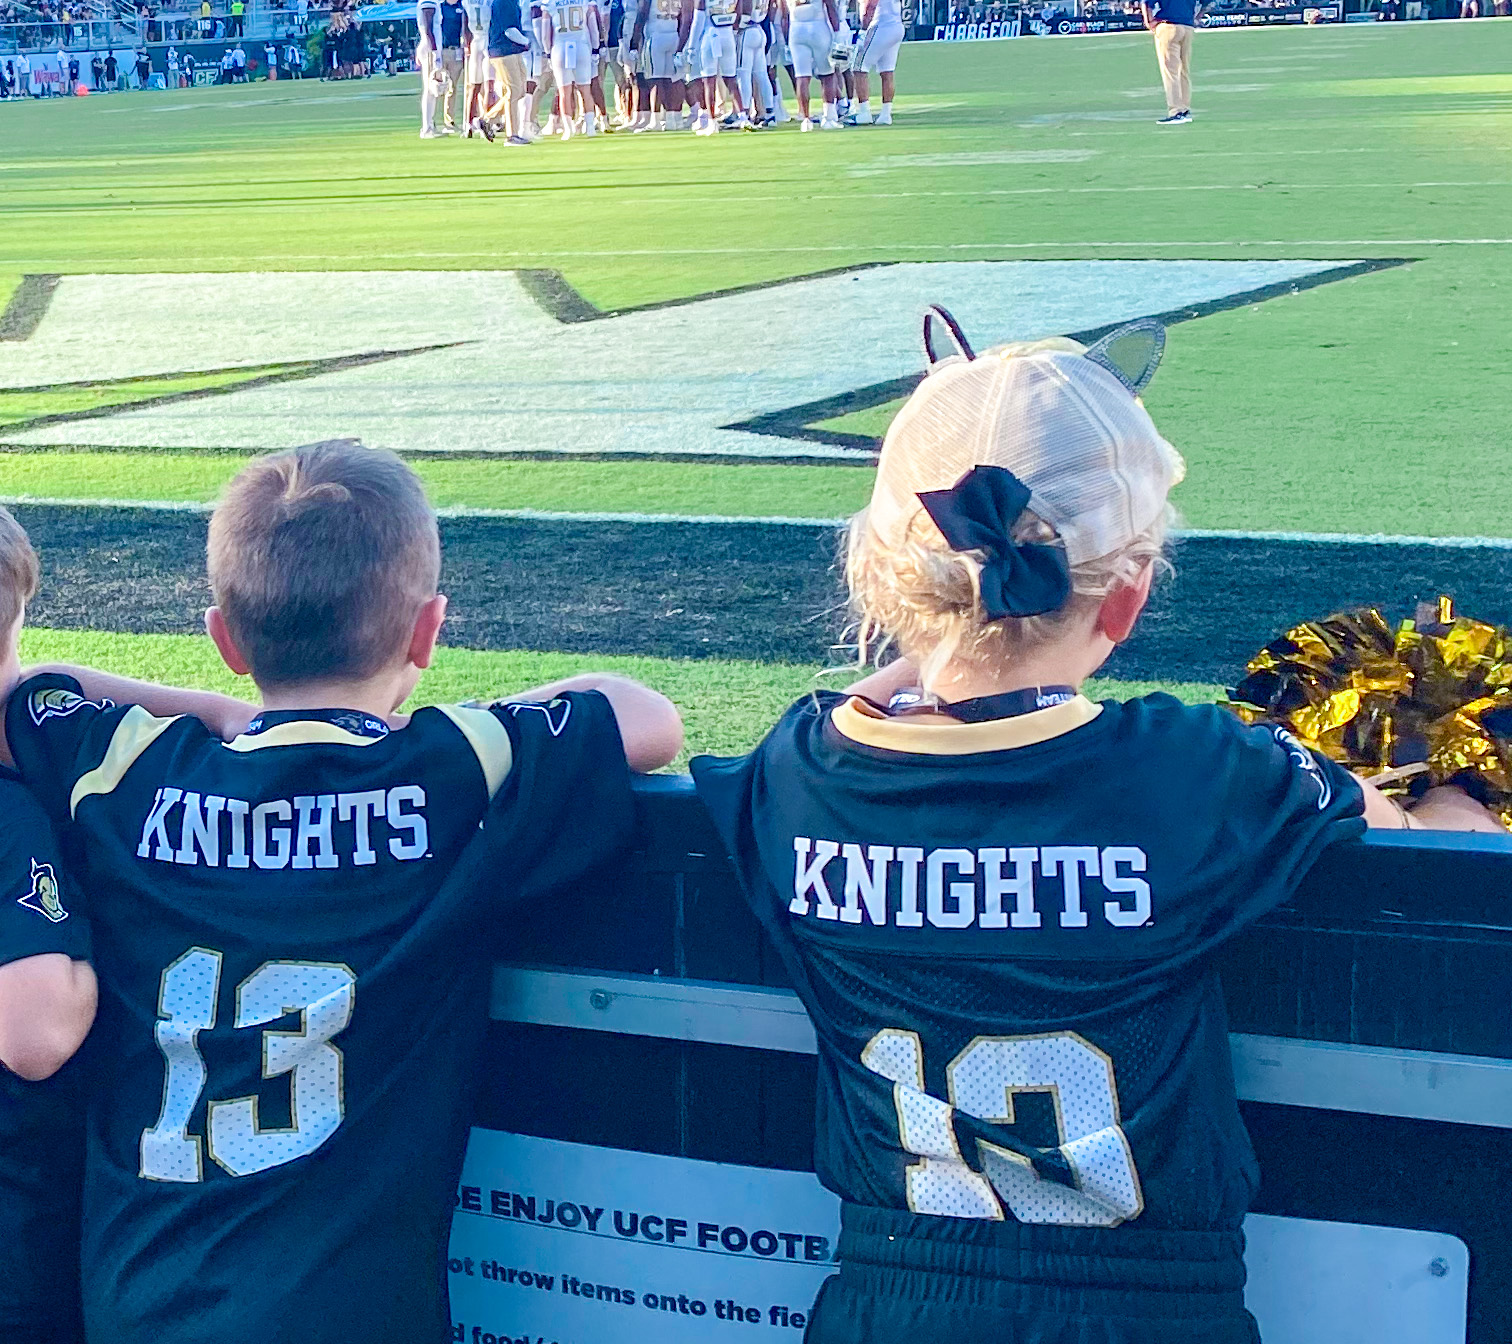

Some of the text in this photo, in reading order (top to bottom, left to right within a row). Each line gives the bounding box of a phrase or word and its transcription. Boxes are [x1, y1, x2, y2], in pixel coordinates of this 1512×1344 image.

[197, 19, 212, 31] 116
[474, 7, 484, 31] 1
[557, 6, 584, 33] 10
[34, 69, 60, 85] Wawa
[137, 784, 430, 870] KNIGHTS
[789, 836, 1152, 929] KNIGHTS
[138, 946, 357, 1183] 13
[490, 1189, 605, 1232] ENJOY
[613, 1210, 688, 1244] UCF
[481, 1261, 555, 1291] throw
[561, 1273, 635, 1305] items
[642, 1290, 707, 1317] onto
[714, 1299, 762, 1324] the
